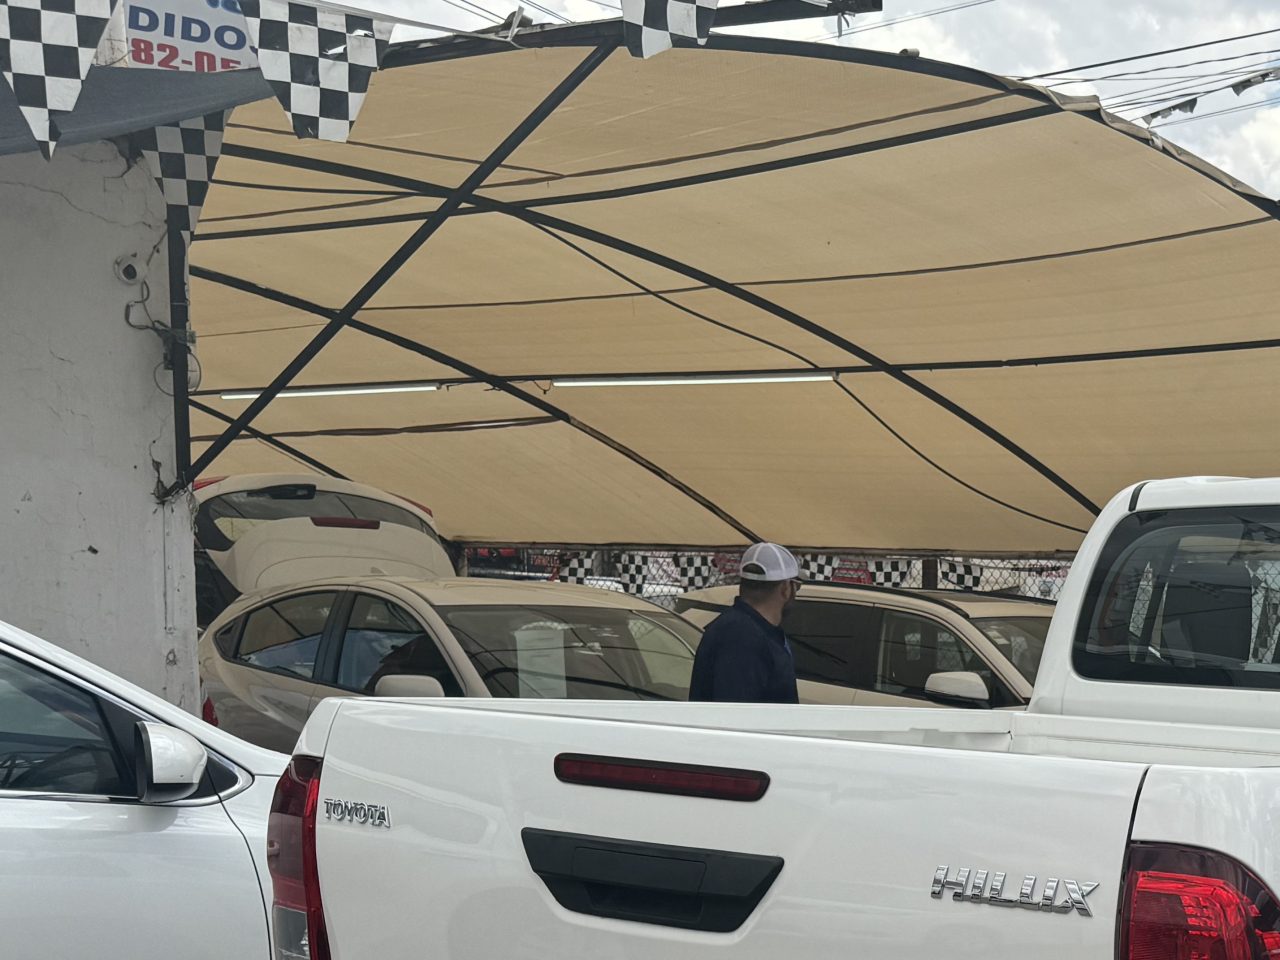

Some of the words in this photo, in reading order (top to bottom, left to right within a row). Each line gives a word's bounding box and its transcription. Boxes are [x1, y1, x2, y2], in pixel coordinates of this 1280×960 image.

[128, 5, 257, 54] DIDO
[324, 798, 392, 829] TOYOTA
[931, 865, 1101, 918] HILUX
